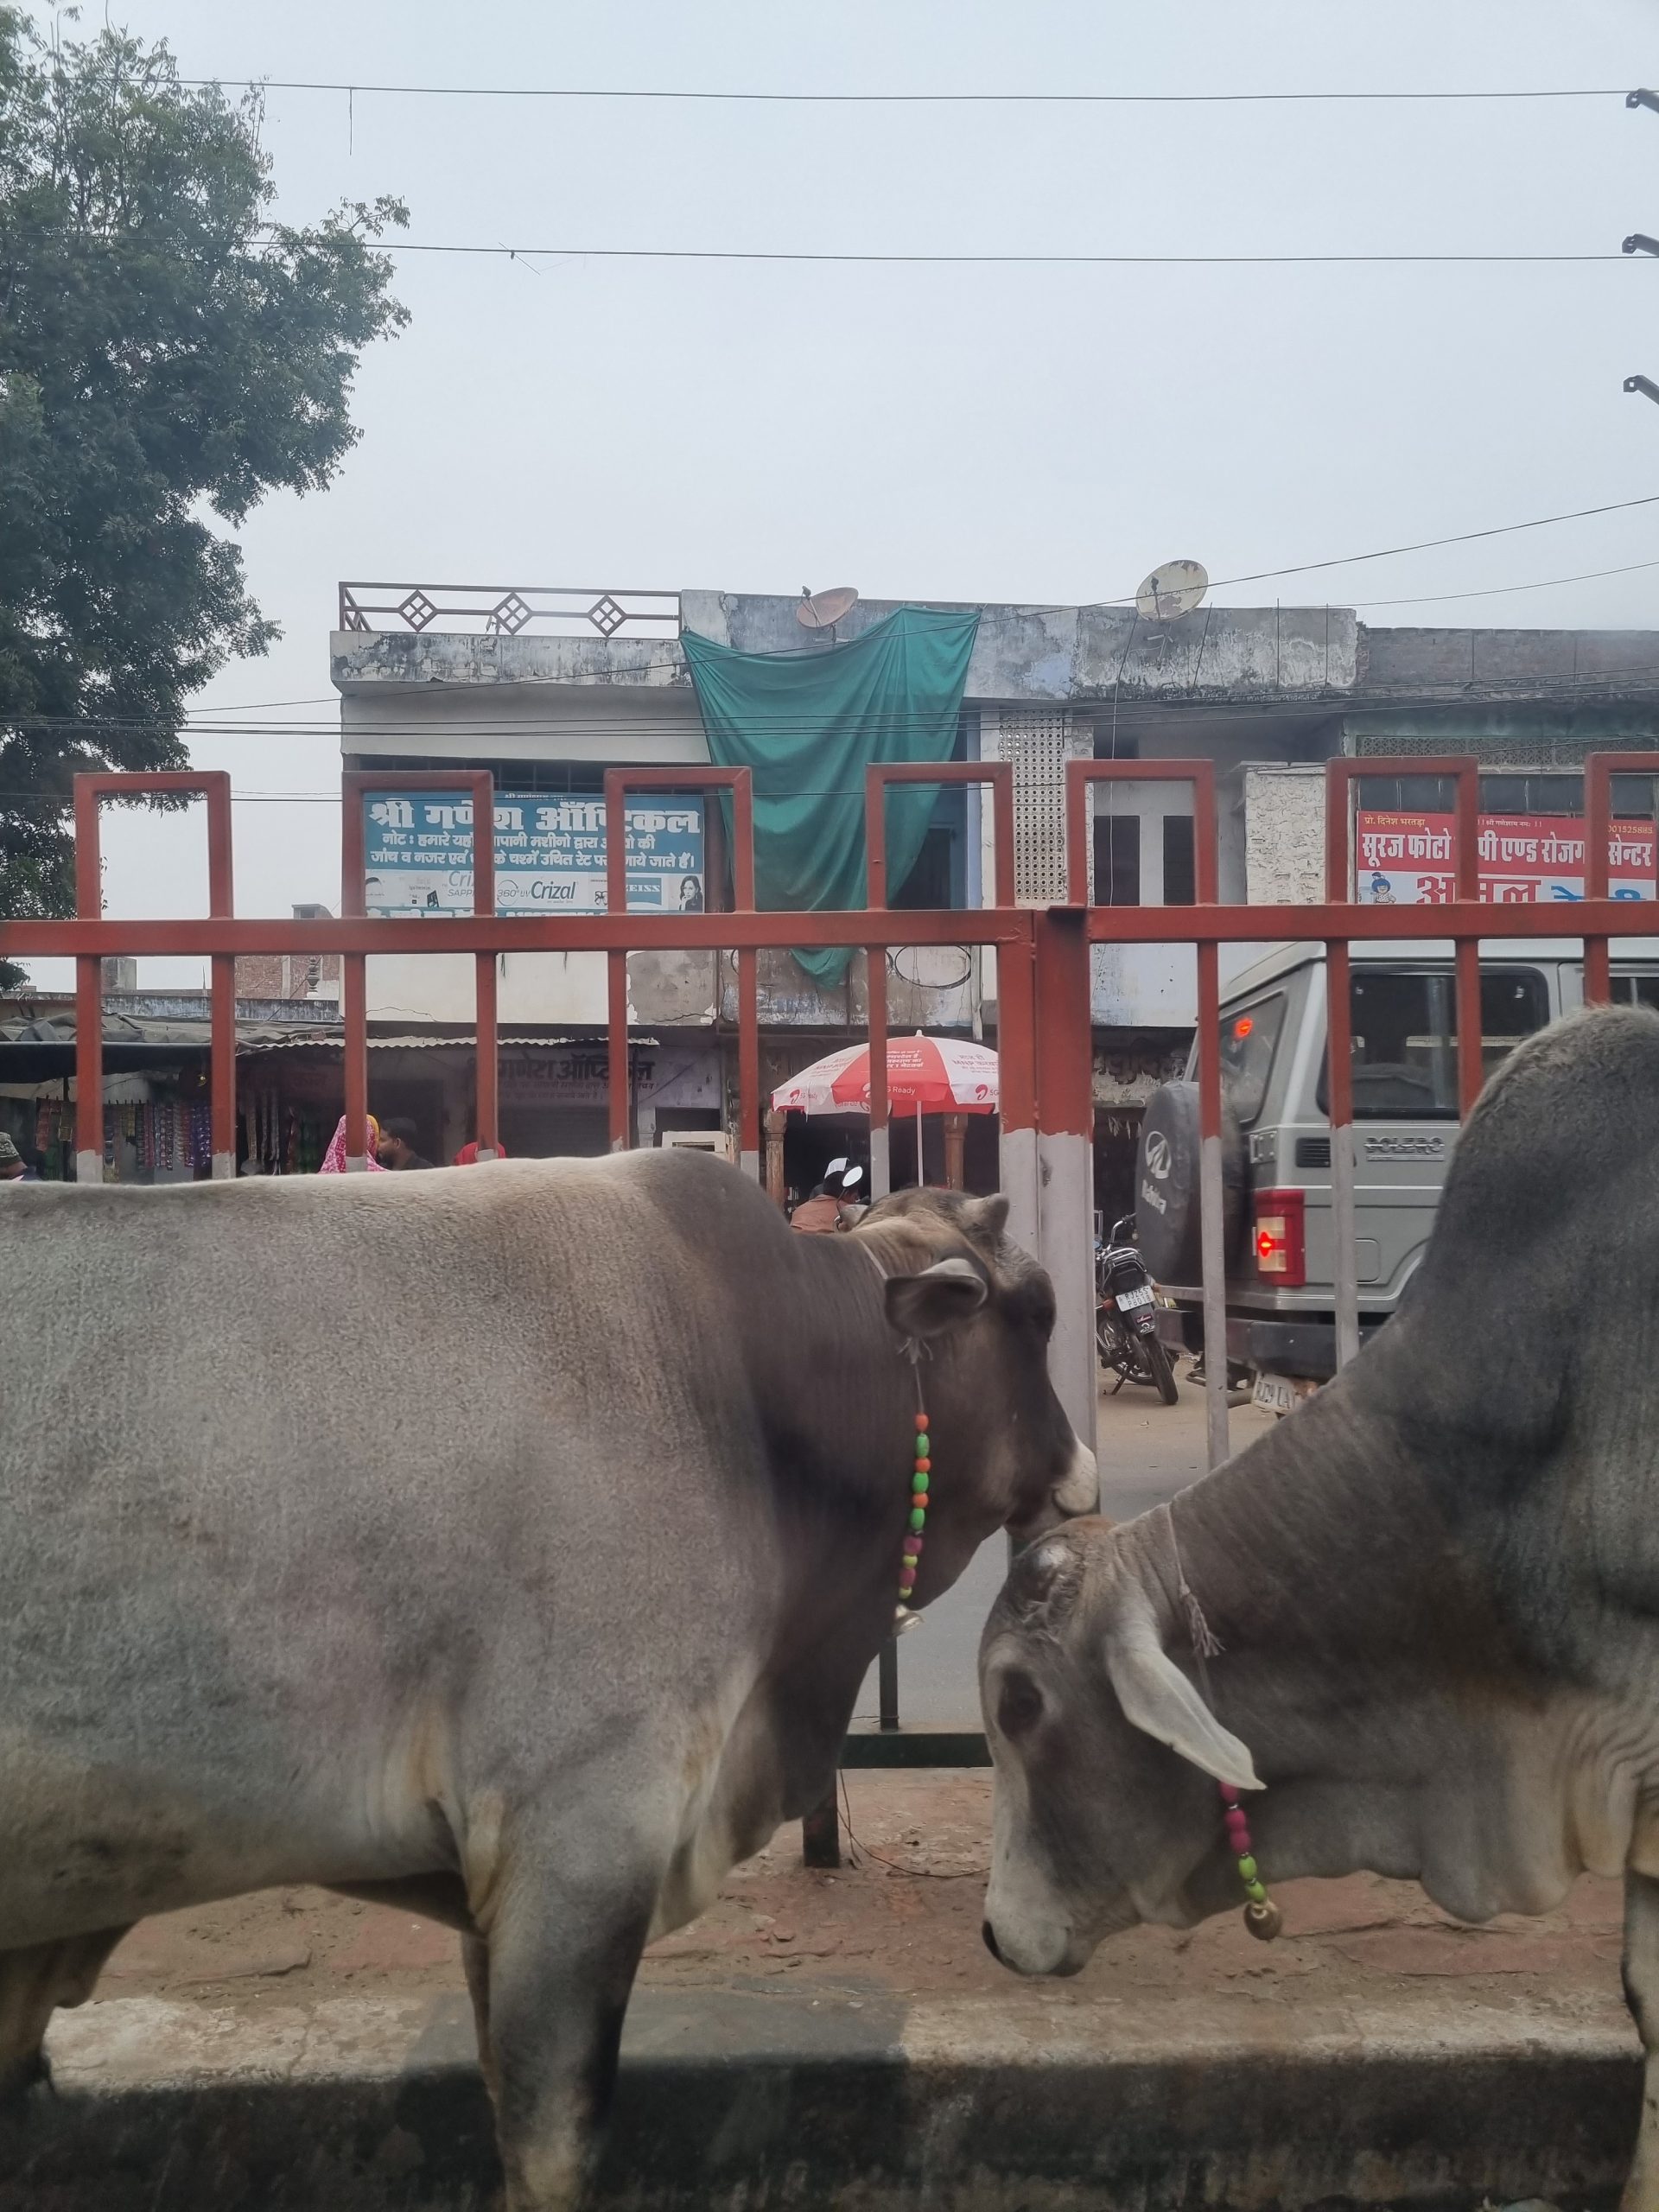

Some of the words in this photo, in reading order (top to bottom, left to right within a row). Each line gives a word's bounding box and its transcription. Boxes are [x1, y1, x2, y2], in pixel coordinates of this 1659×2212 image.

[369, 798, 415, 828] श्री
[1378, 816, 1398, 825] दिनेश
[417, 830, 450, 846] हमारे
[638, 834, 656, 849] की
[1362, 834, 1405, 868] सूरज
[1408, 828, 1452, 860] फोटो
[1501, 838, 1539, 862] एण्ड
[1608, 834, 1653, 867] सेन्टर
[401, 852, 412, 862] व
[414, 852, 447, 864] नजर
[448, 849, 469, 864] एवं
[575, 850, 593, 866] रेट
[649, 853, 677, 868] जाते
[531, 881, 576, 899] Crizal
[893, 1085, 916, 1096] Ready
